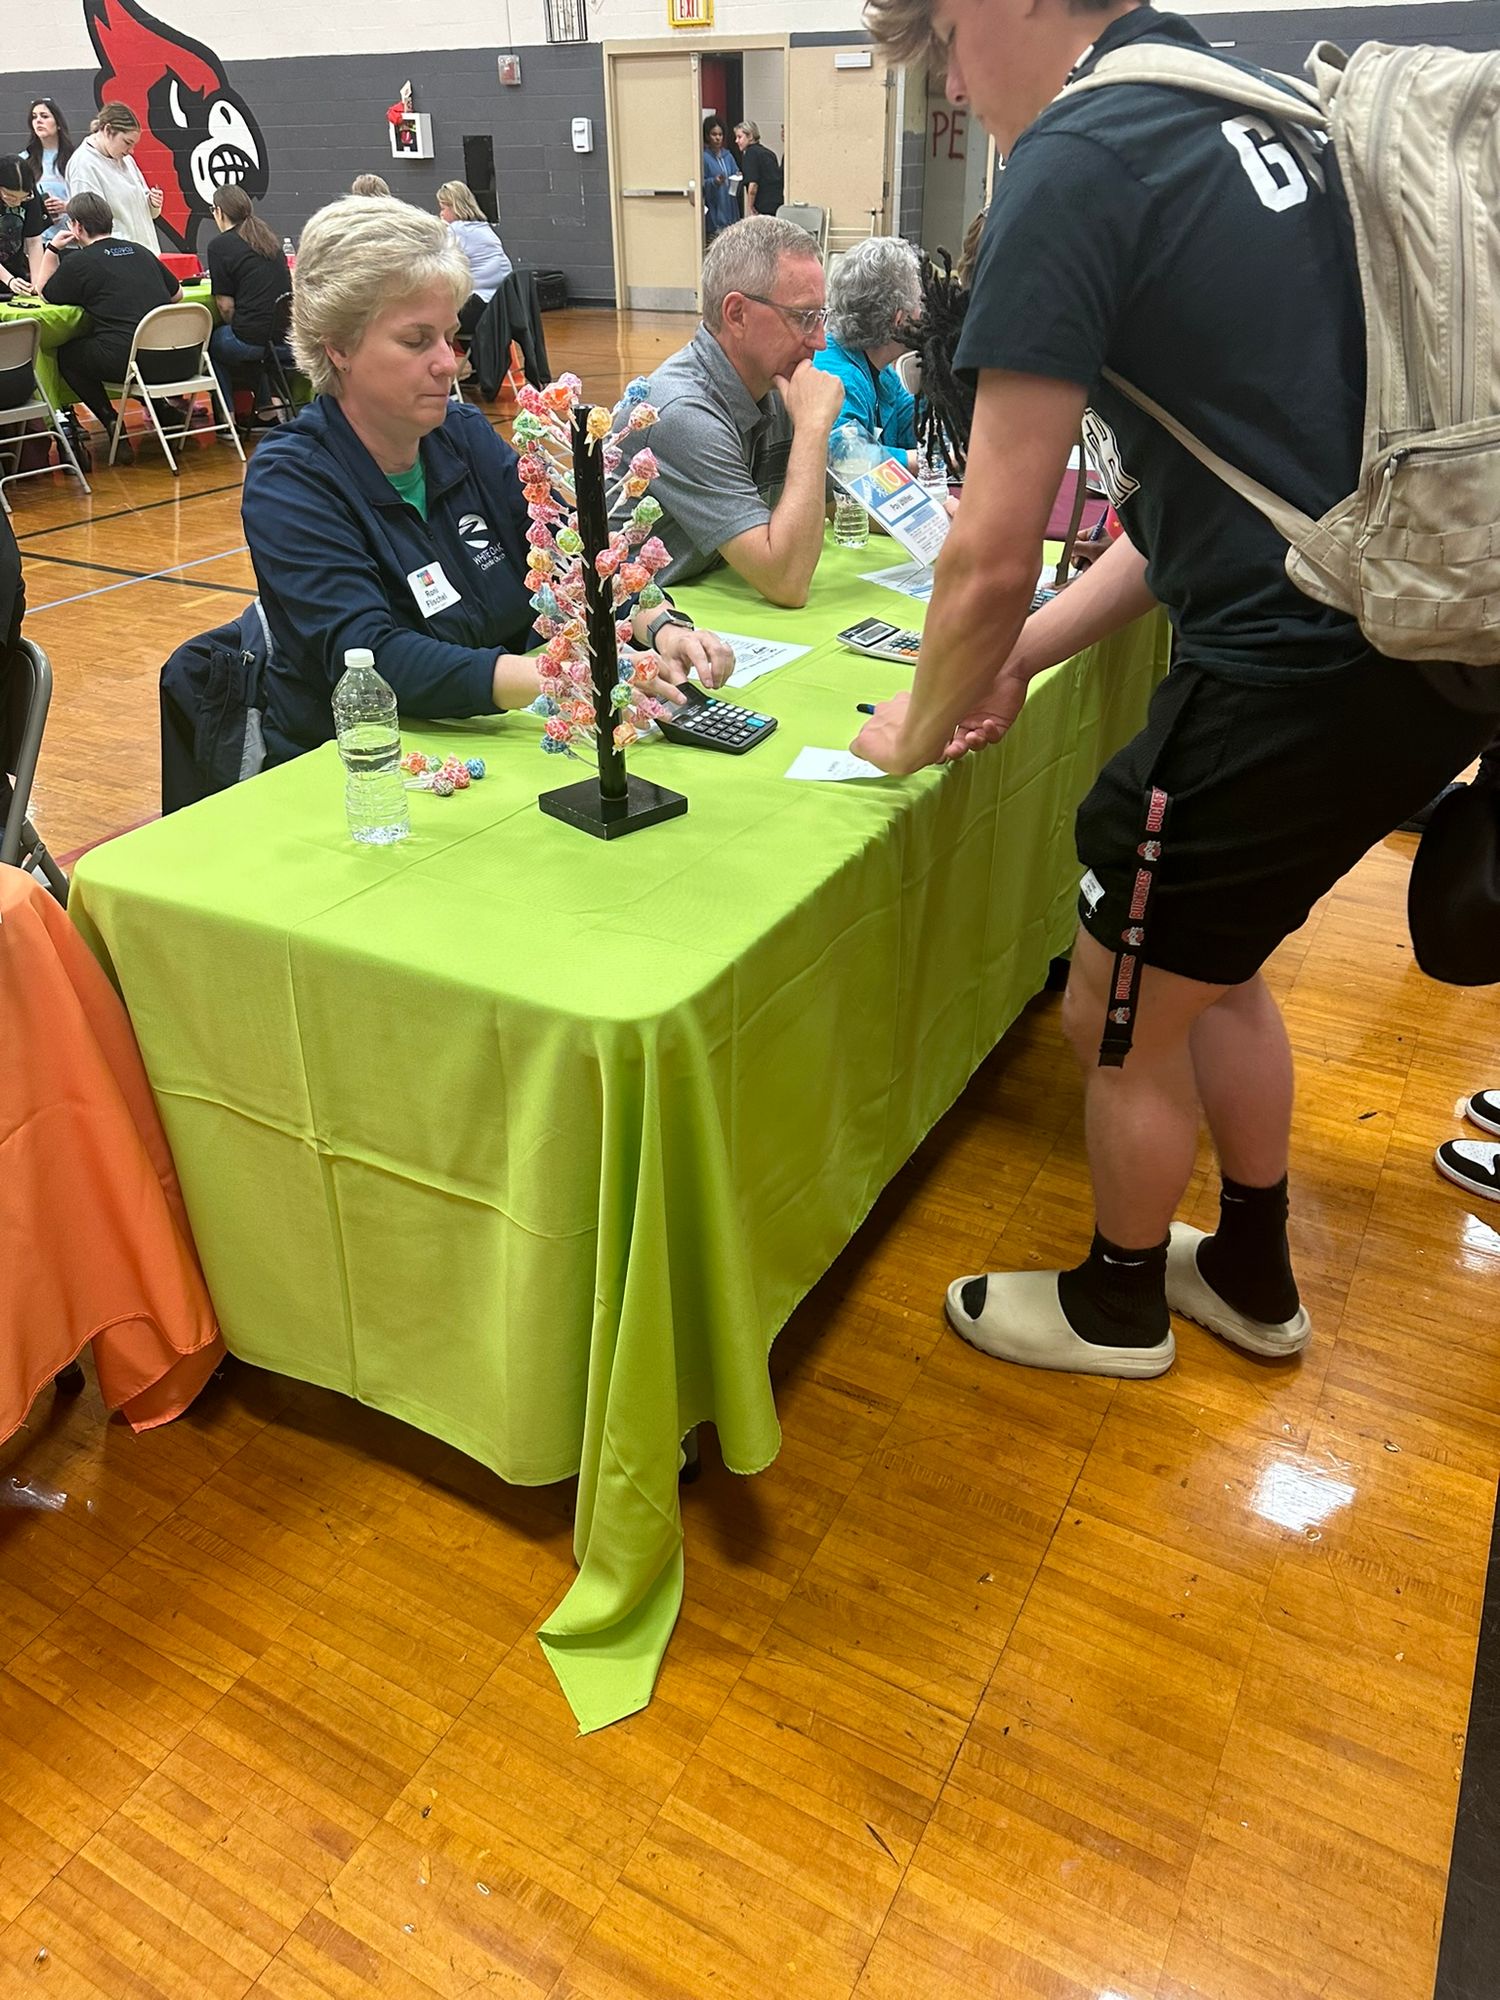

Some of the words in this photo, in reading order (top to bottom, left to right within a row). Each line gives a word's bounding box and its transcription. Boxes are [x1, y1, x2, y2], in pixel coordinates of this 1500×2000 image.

[932, 110, 966, 160] PE
[472, 549, 491, 565] WHITE
[489, 542, 504, 556] OAK
[1129, 871, 1152, 919] BUCKEYES
